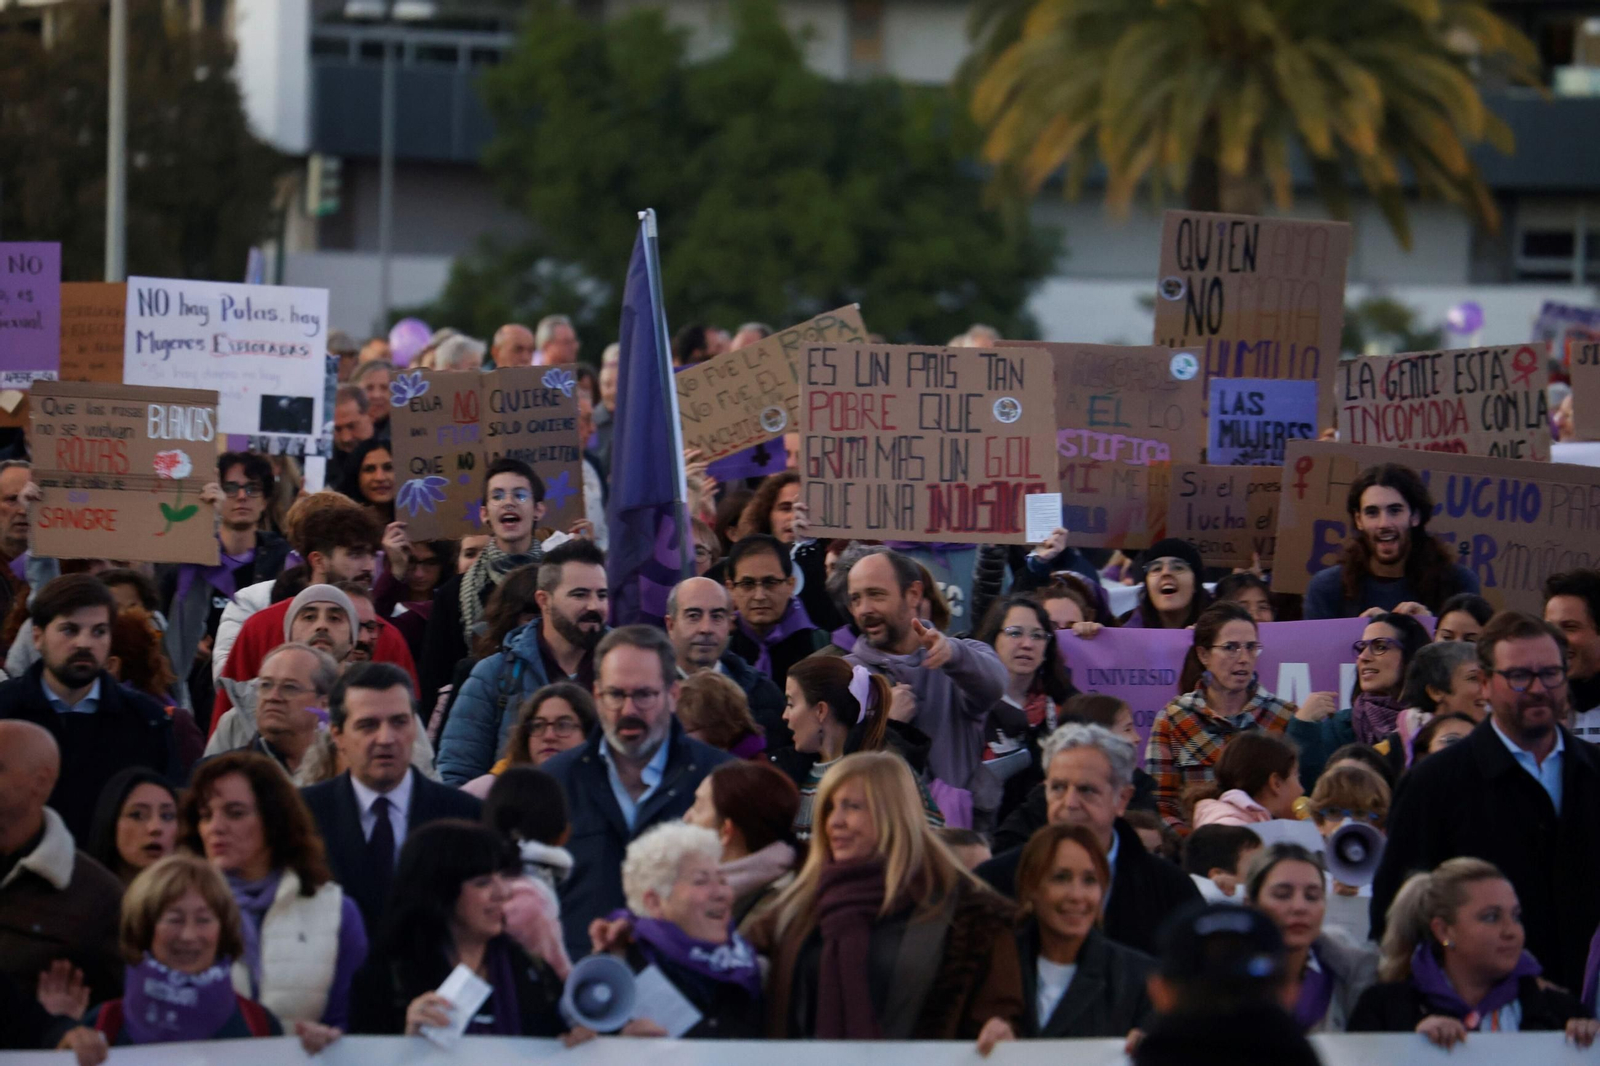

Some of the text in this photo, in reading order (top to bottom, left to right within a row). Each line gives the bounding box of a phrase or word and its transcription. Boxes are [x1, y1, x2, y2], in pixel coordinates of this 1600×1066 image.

[8, 253, 44, 275] NO
[137, 287, 170, 317] NO
[178, 291, 210, 327] hay
[290, 304, 322, 338] hay
[1182, 274, 1224, 337] NO
[743, 347, 771, 370] LA
[807, 347, 837, 386] ES
[855, 350, 890, 387] UN
[979, 353, 1024, 391] TAN
[1344, 361, 1376, 401] LA
[1384, 353, 1442, 402] GENTE
[41, 396, 77, 416] Que
[147, 404, 215, 442] BLANCAS
[409, 387, 562, 424] ELLA NO QUIERE
[678, 402, 713, 423] NO
[808, 390, 898, 431] POBRE
[918, 393, 983, 434] QUE
[1149, 400, 1184, 432] LO
[1219, 390, 1264, 416] LAS
[1344, 388, 1551, 444] INCOMODA CON LA
[1217, 419, 1314, 449] MUJERES
[55, 437, 131, 474] ROJAS
[456, 451, 476, 471] NO
[806, 435, 1041, 482] GRITA MAS UN GOL
[1179, 471, 1208, 498] Si
[1216, 475, 1234, 498] el
[38, 505, 119, 531] SANGRE
[806, 481, 856, 529] QUE
[866, 483, 915, 531] UNA
[1186, 502, 1248, 531] lucha
[1254, 506, 1274, 531] el
[1087, 668, 1177, 686] UNIVERSID
